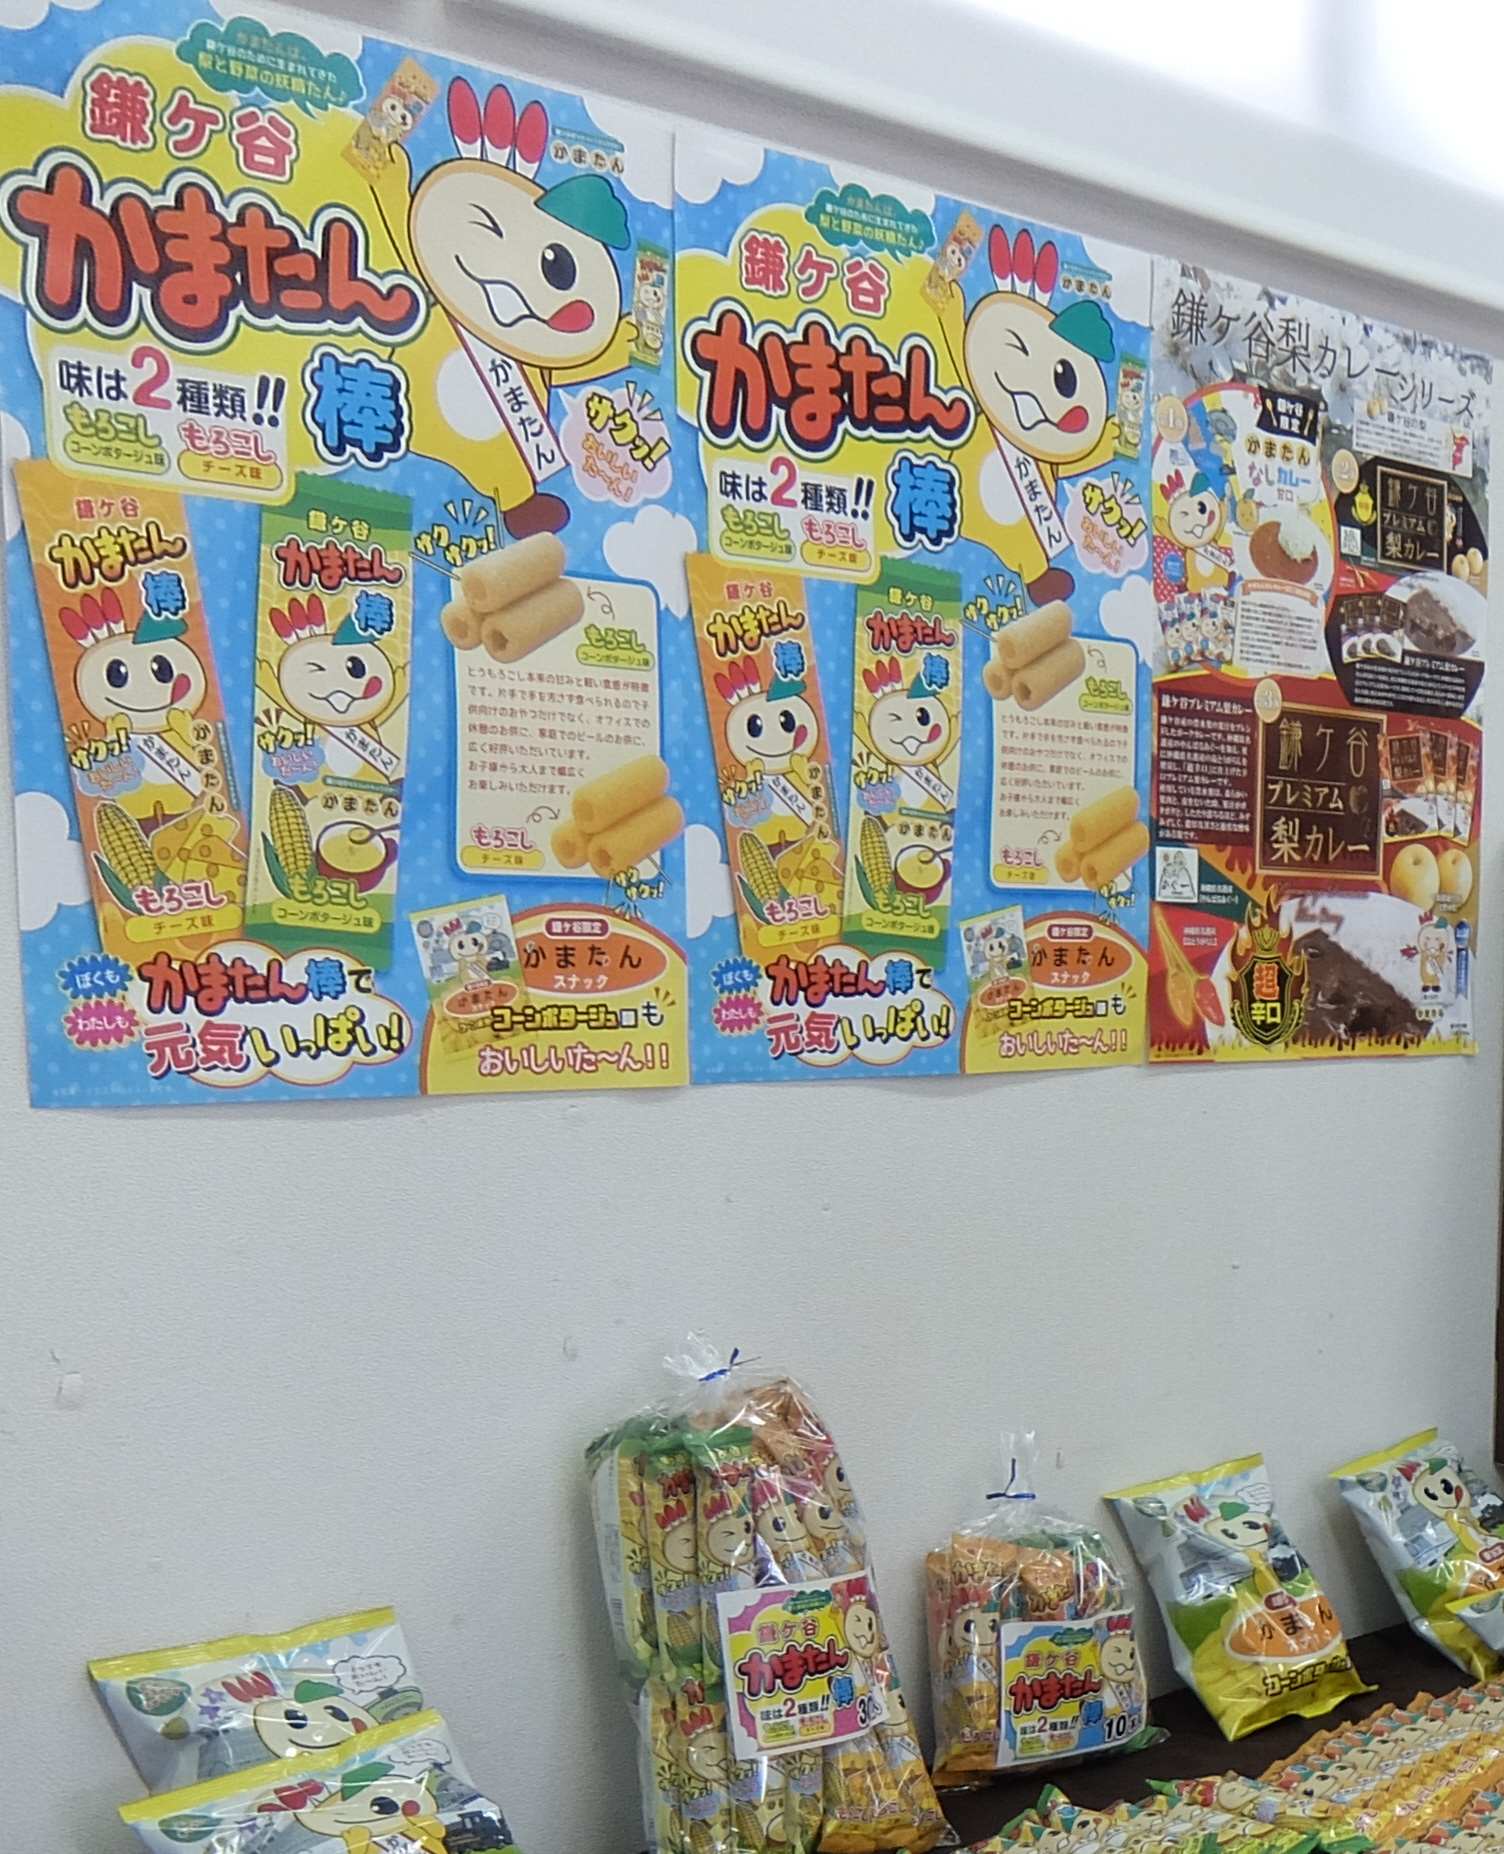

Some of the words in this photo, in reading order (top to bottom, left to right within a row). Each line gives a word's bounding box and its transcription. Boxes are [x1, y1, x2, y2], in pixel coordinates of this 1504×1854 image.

[84, 70, 298, 181] 鎌ケ谷
[554, 142, 624, 174] かまたん
[9, 160, 420, 337] かまたん
[741, 234, 888, 316] 鎌ケ谷
[694, 310, 968, 448] かまたん
[63, 401, 162, 448] もろこし
[310, 352, 405, 465] 棒
[488, 357, 556, 470] かまたん
[70, 440, 165, 466] コーンポタージュ味
[178, 418, 276, 464] もろこし
[1248, 437, 1310, 466] かまたん
[202, 460, 262, 479] チーズ味
[1248, 461, 1311, 487] なしカレー
[891, 457, 960, 546] 棒
[1014, 456, 1063, 551] かまたん
[721, 504, 791, 540] もろこし
[802, 515, 867, 551] もろこし
[48, 520, 187, 588] かまたん
[275, 537, 402, 589] かまたん
[817, 549, 857, 563] チーズ味
[1385, 531, 1440, 561] 梨カレー
[141, 570, 187, 616] 棒
[354, 591, 395, 634] 棒
[706, 600, 805, 656] かまたん
[584, 624, 646, 653] もろこし
[867, 609, 956, 654] かまたん
[1086, 676, 1127, 700] もろこし
[143, 736, 192, 783] かまたん
[345, 729, 393, 771] かまたん
[1278, 718, 1369, 778] 鎌ケ谷
[193, 724, 226, 813] かまたん
[468, 778, 571, 796] お楽しみいただけます。
[1267, 782, 1344, 812] プレミアム
[321, 794, 400, 818] かまたん
[471, 824, 535, 852] もろこし
[1001, 845, 1043, 867] もろこし
[1270, 816, 1370, 864] 梨カレー
[481, 854, 524, 866] チーズ味
[133, 880, 228, 915] もろこし
[289, 872, 369, 908] もろこし
[876, 889, 932, 918] もろこし
[152, 914, 216, 935] チーズ味
[277, 907, 375, 929] コーンポタージュ味
[764, 894, 829, 924] もろこし
[523, 944, 642, 970] かまたん
[1031, 946, 1114, 967] かまたん
[75, 971, 121, 990] ぼくも
[138, 952, 375, 1015] かまたん棒で
[552, 974, 608, 990] スナック
[766, 954, 932, 1007] かまたん棒で
[1051, 972, 1090, 983] スナック
[1253, 963, 1280, 999] 超
[77, 1016, 130, 1032] わたしも
[491, 1000, 665, 1032] コーンポタージュも
[767, 999, 951, 1059] 元気いっぱい!
[1250, 1002, 1282, 1025] 辛口
[142, 1005, 407, 1080] 元気いっぱい!
[739, 1637, 849, 1697] かまたん
[1009, 1668, 1102, 1714] かまたん
